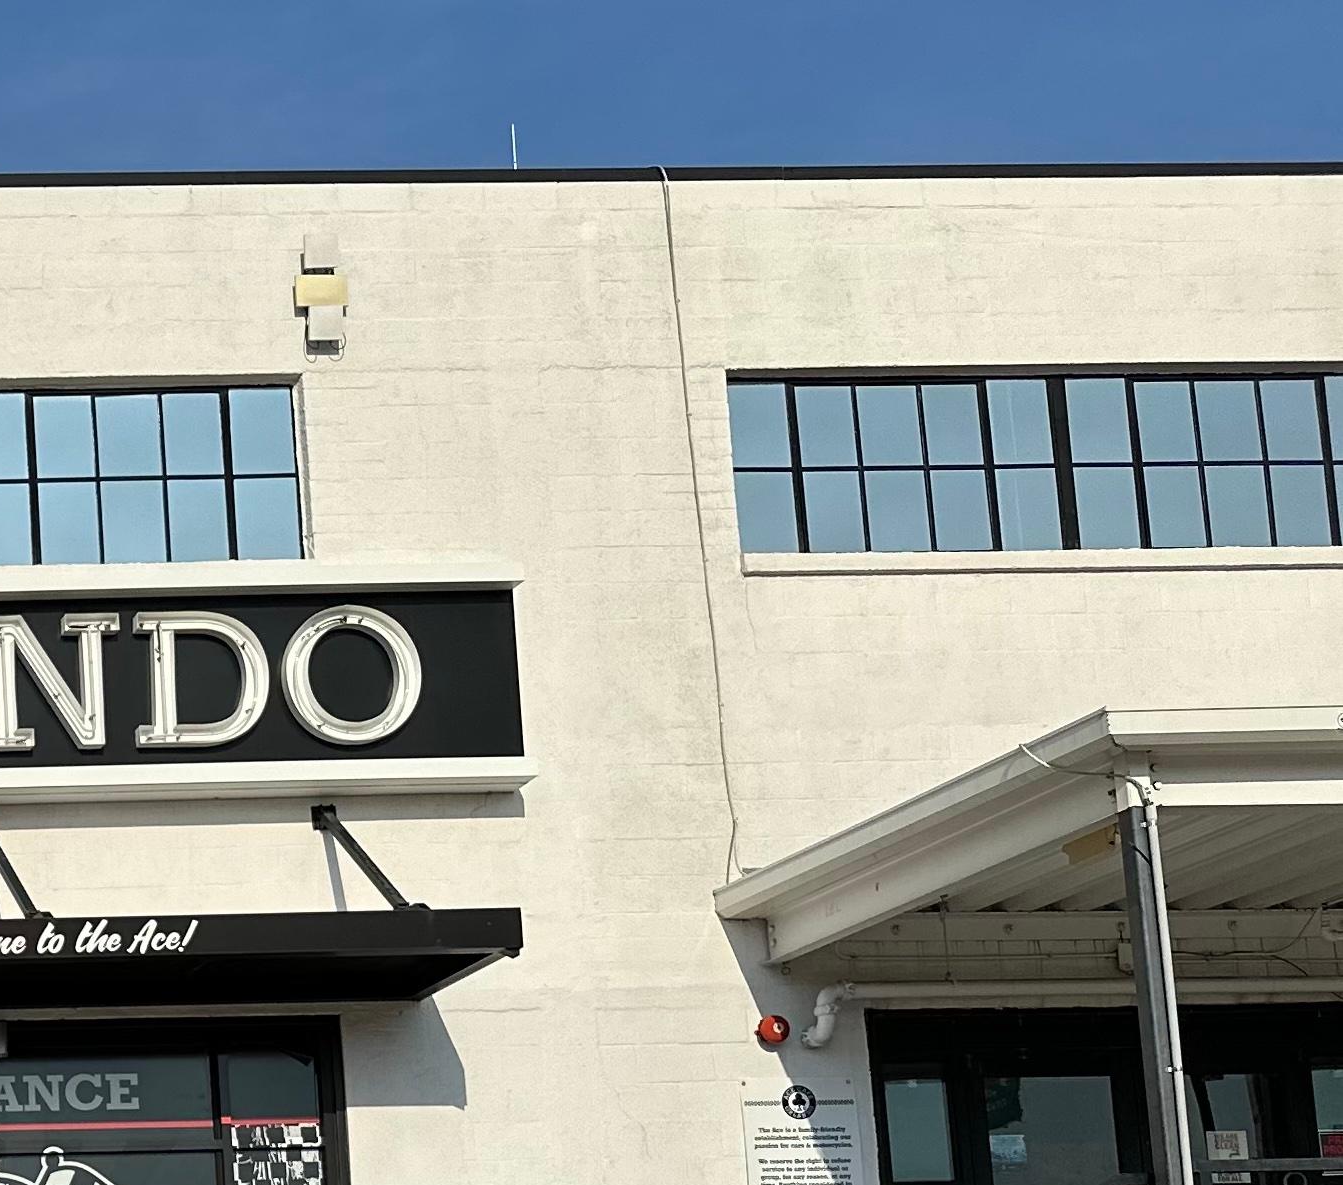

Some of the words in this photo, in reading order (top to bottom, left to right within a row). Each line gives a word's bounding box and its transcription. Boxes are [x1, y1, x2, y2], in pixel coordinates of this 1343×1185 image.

[37, 921, 65, 954] to
[75, 919, 123, 953] the
[126, 919, 199, 955] Ace!
